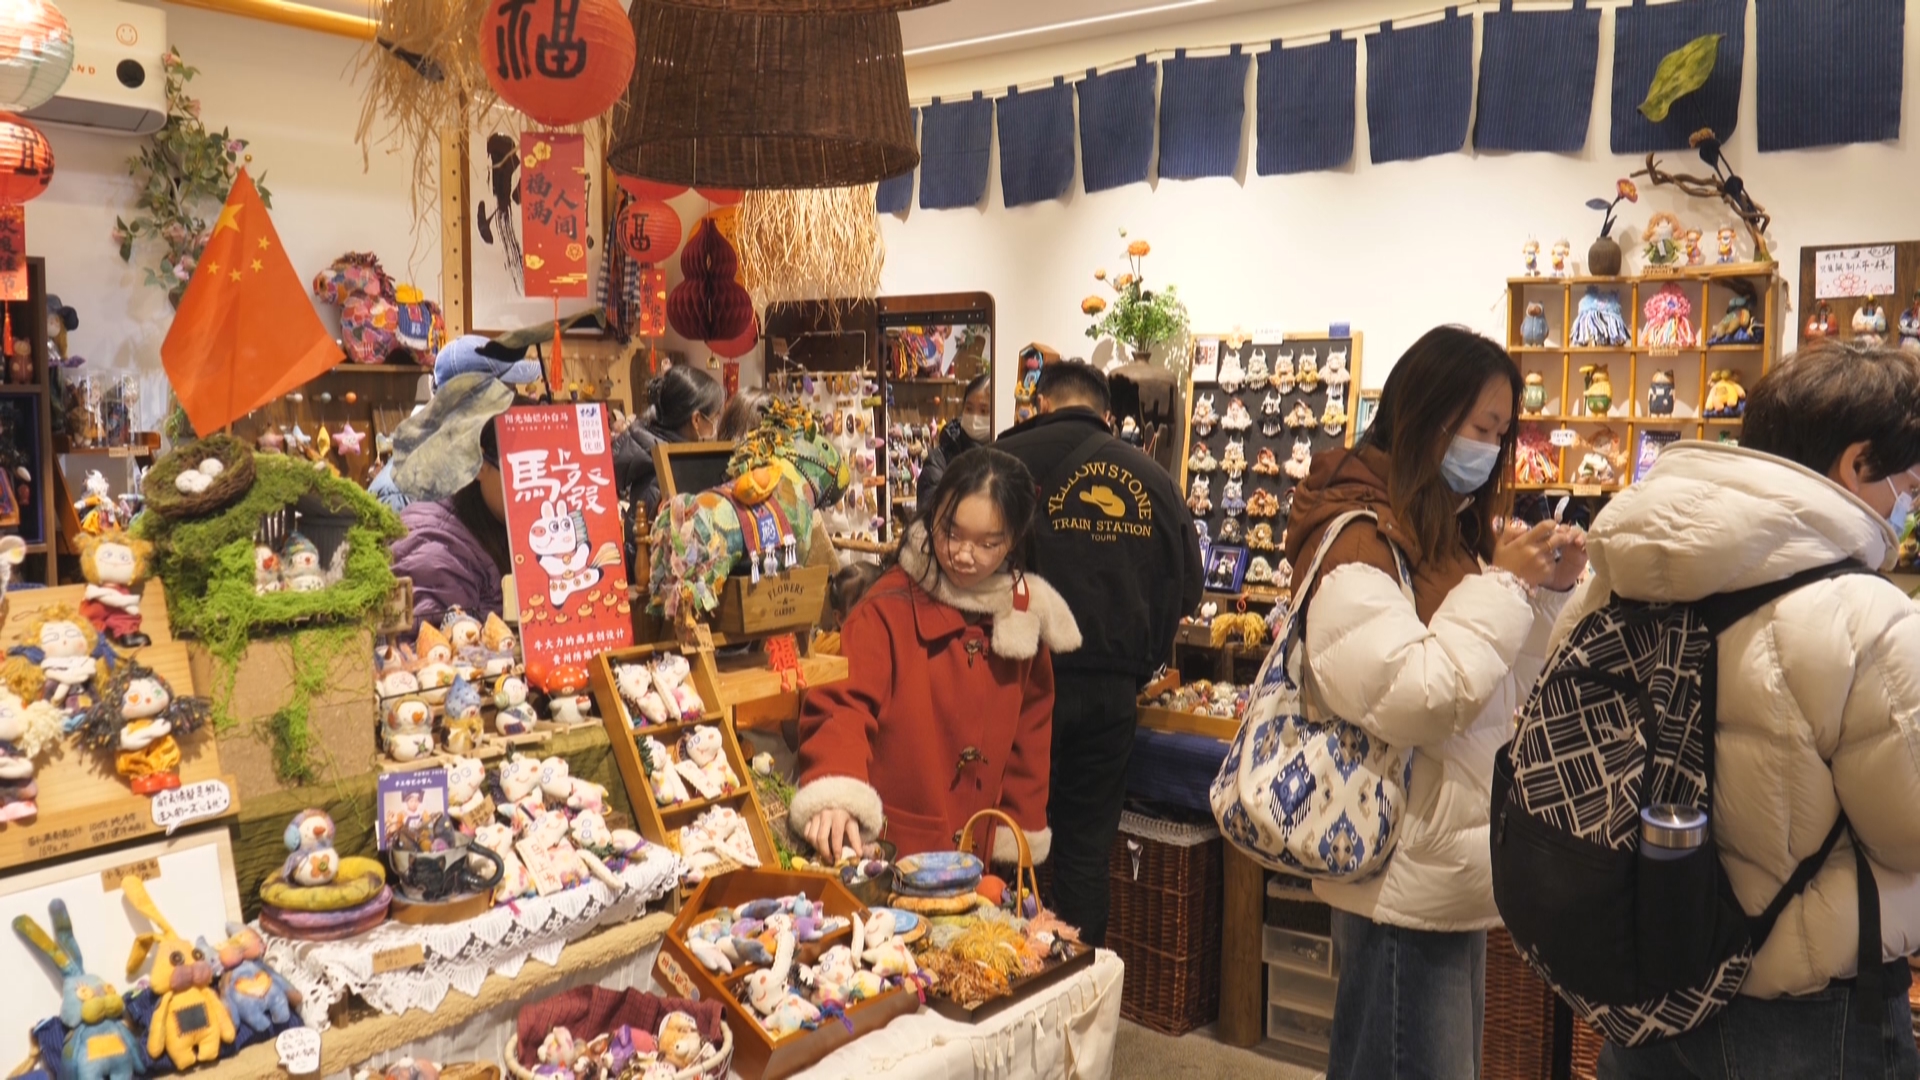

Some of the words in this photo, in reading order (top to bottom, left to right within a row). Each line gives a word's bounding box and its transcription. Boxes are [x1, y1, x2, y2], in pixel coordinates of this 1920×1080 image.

[496, 0, 587, 80] 福
[71, 64, 96, 75] ND
[526, 171, 553, 227] 福满
[553, 189, 580, 242] 人间
[616, 211, 651, 252] 福
[504, 412, 569, 424] 阳光灿烂小白马
[1048, 462, 1152, 520] YELLOWSTONE
[1052, 518, 1091, 531] TRAIN
[1096, 520, 1152, 537] STATION
[1091, 533, 1117, 542] TOURS
[768, 583, 804, 600] FLOWERS
[774, 607, 796, 617] GARDEN
[767, 634, 798, 671] 福
